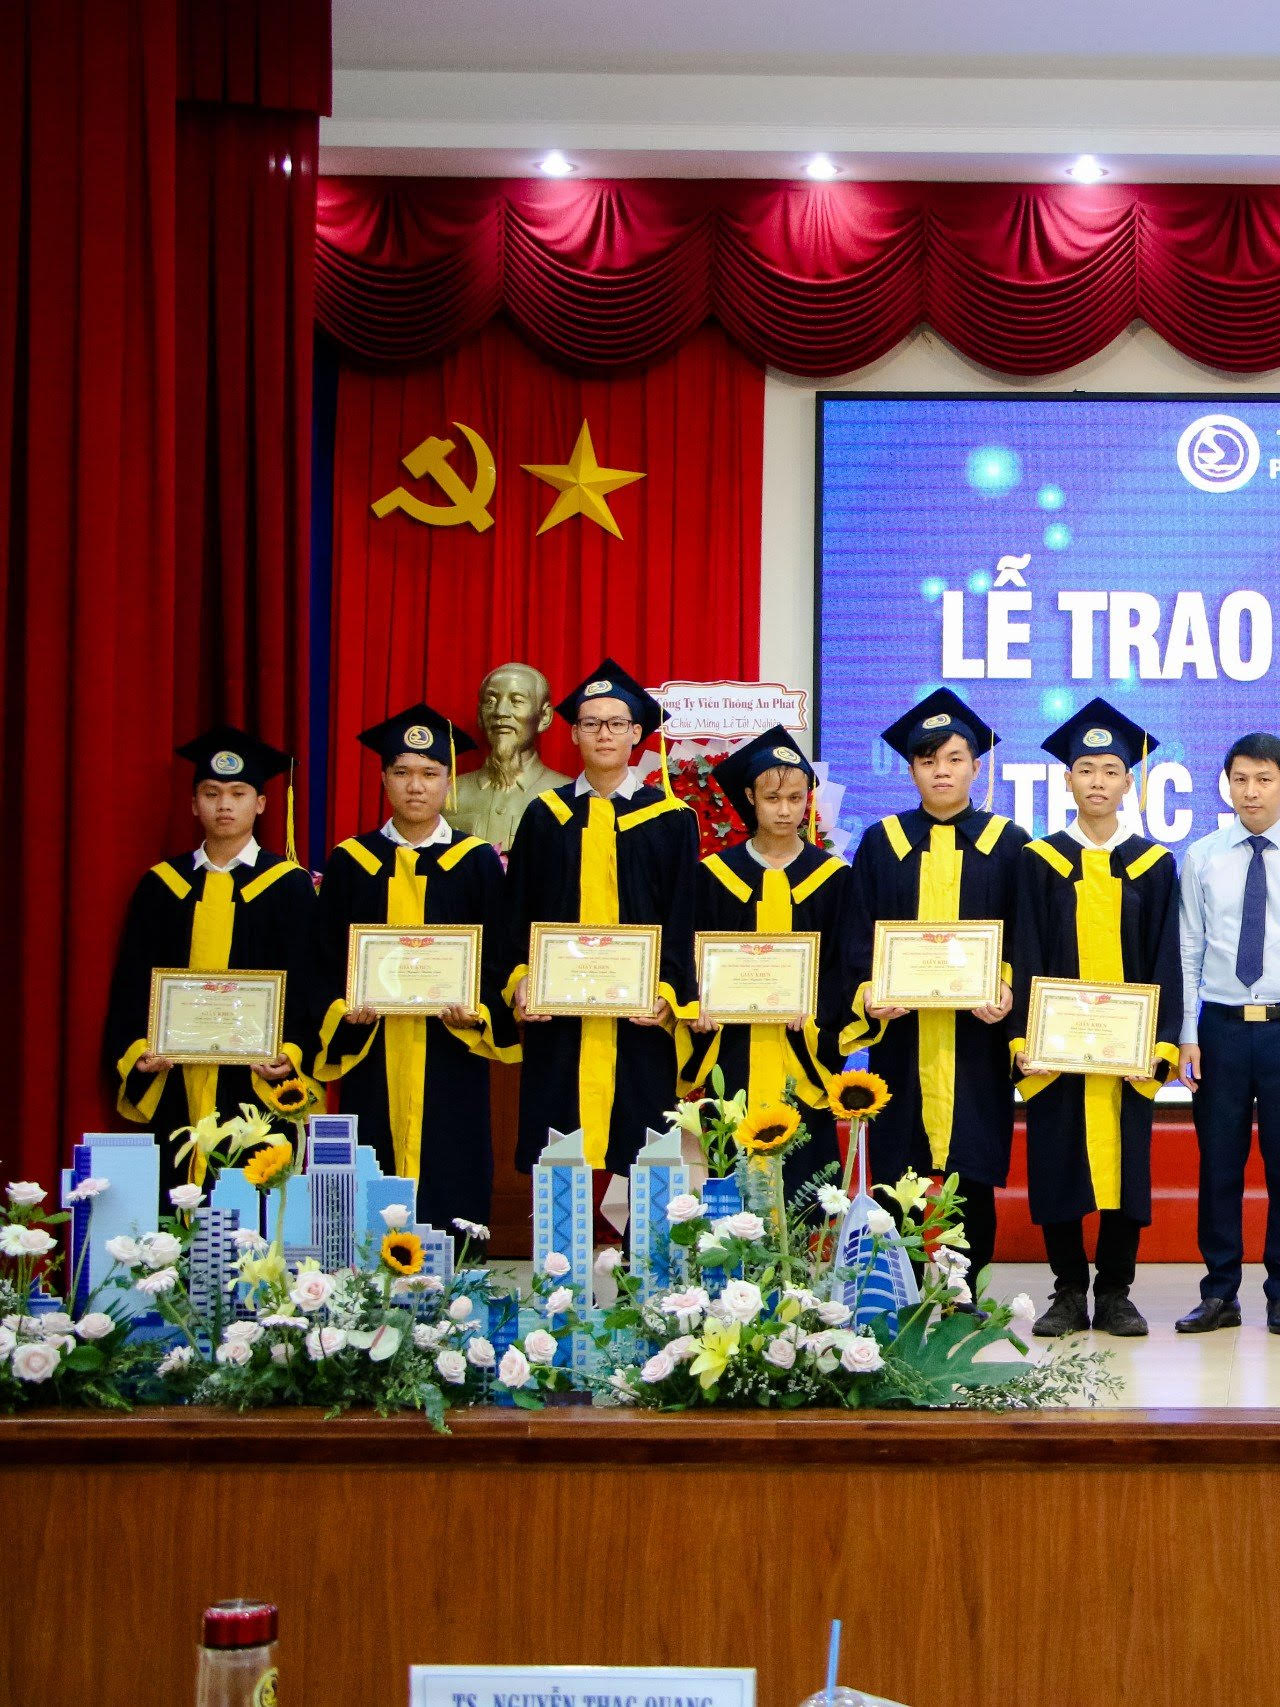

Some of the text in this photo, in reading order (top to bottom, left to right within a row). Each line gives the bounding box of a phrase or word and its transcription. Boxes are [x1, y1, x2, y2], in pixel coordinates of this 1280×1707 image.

[941, 552, 1033, 680] LỄ
[1056, 589, 1273, 681] TRAO
[684, 697, 695, 711] Ty
[722, 697, 753, 711] Thông
[756, 698, 770, 709] An
[772, 698, 795, 709] Phát
